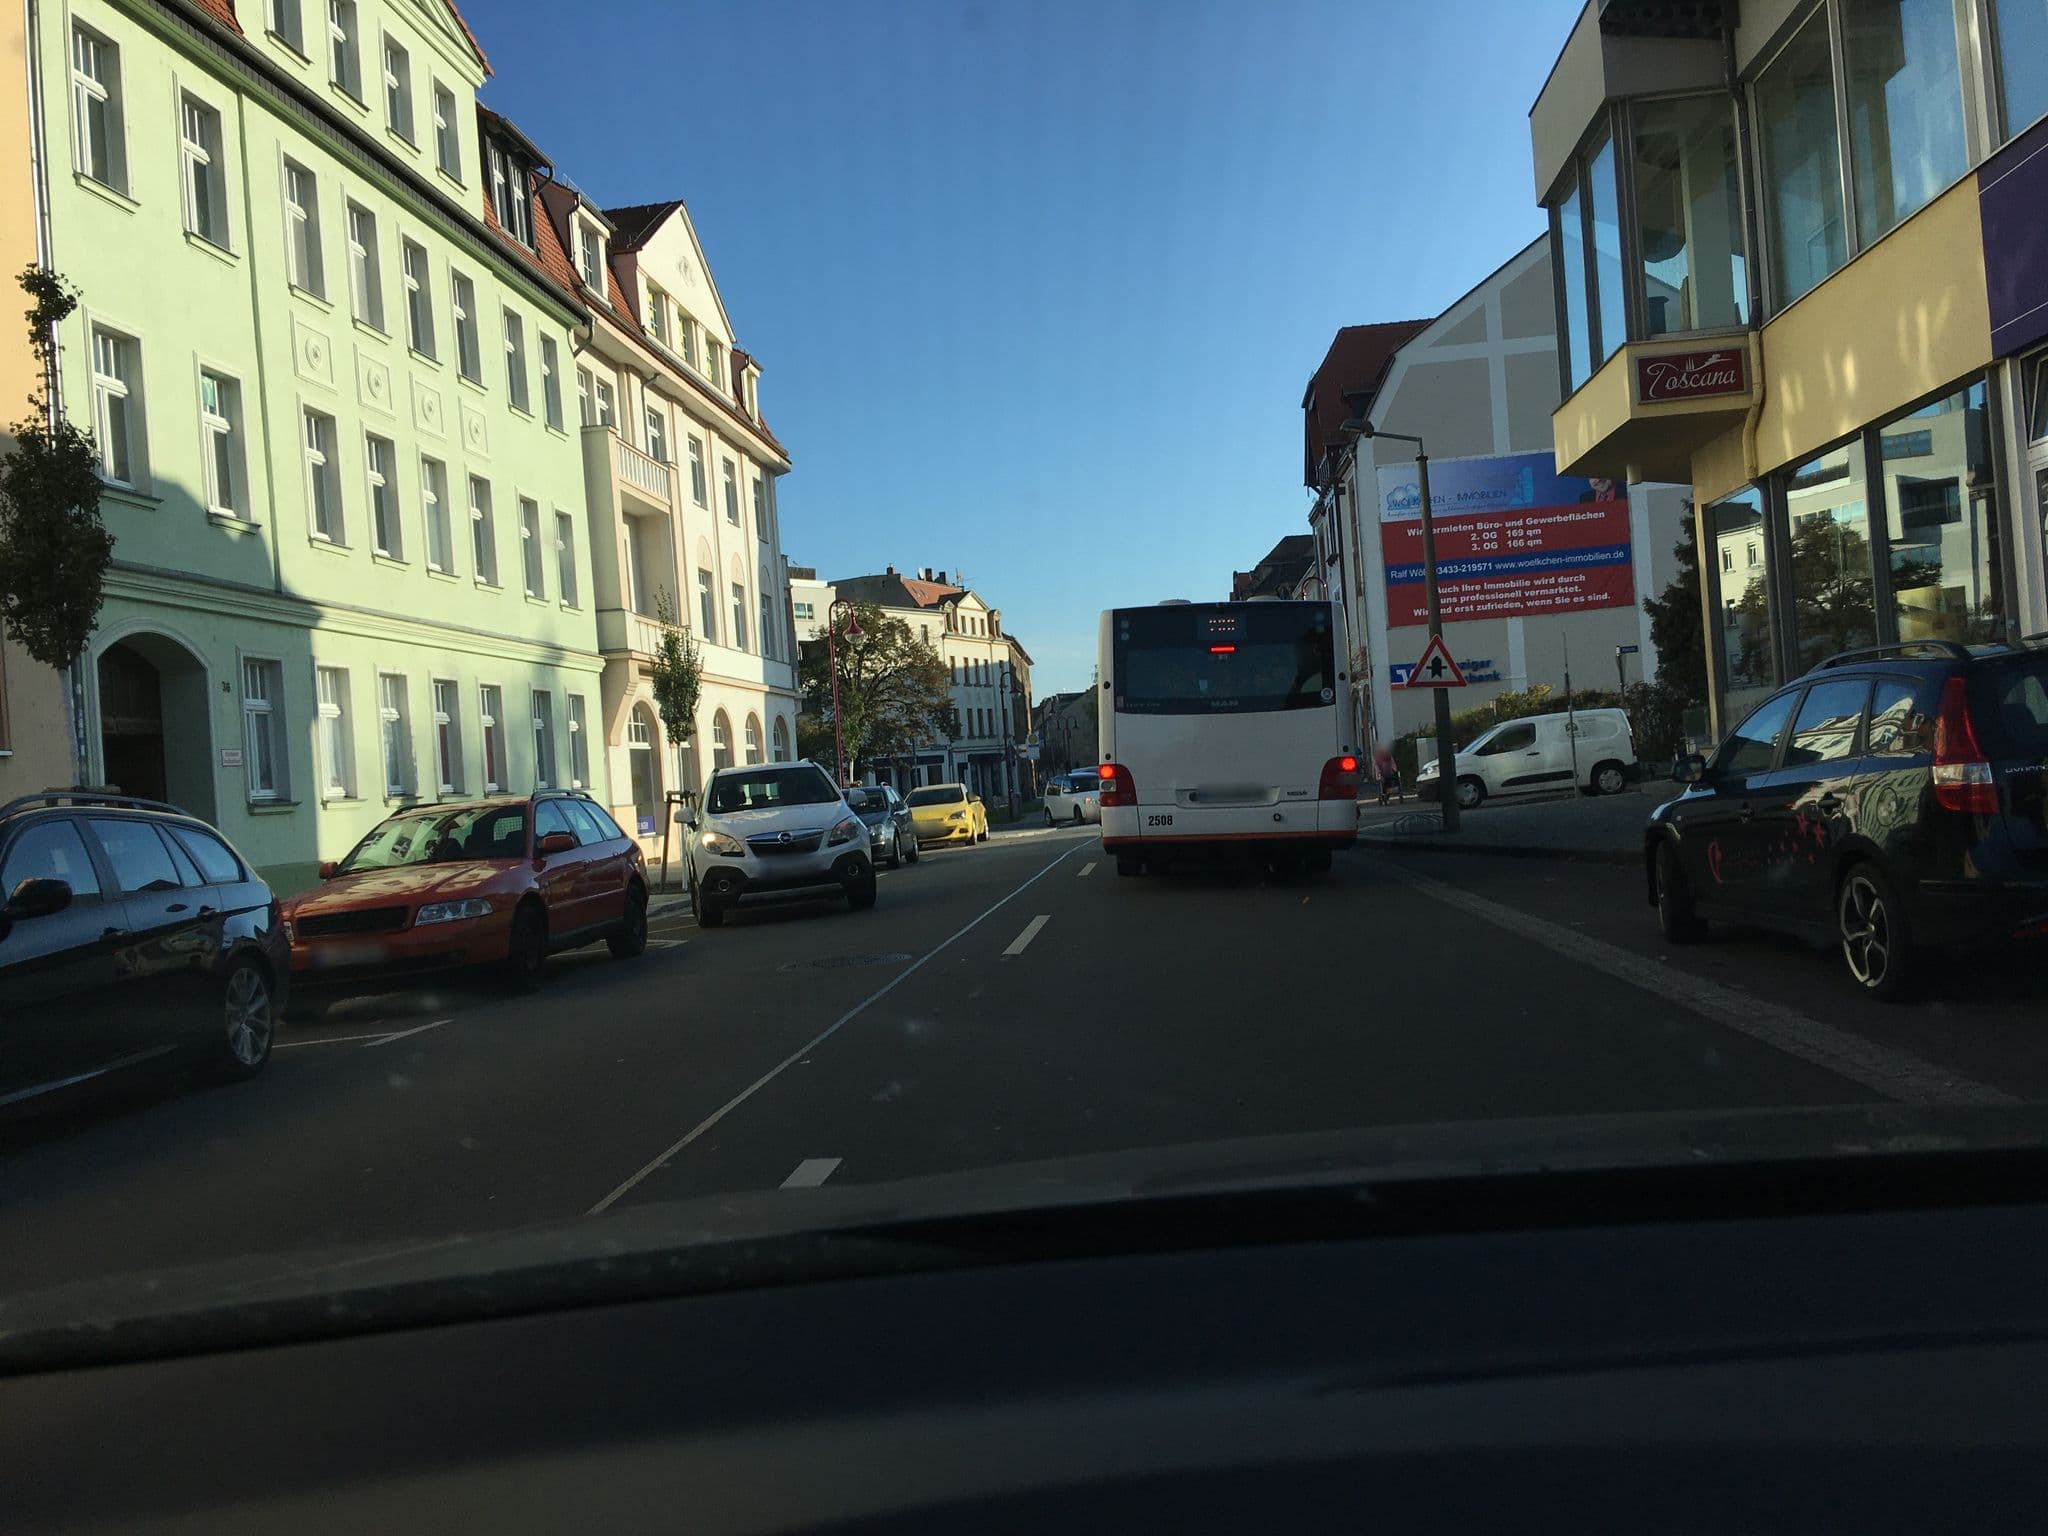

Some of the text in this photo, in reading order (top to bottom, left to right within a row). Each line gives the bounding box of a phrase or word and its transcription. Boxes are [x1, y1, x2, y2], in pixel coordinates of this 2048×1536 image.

[1646, 362, 1737, 398] Toscana
[1407, 511, 1605, 537] Wir ermieten Büro- und Gewerbeflächen
[1470, 528, 1542, 541] 2. OG 169 qm
[1471, 538, 1543, 551] 3. OG 166 qm
[1390, 569, 1408, 578] Ralf
[1409, 568, 1426, 577] Wöl
[1495, 550, 1625, 569] www.woelkchen-immobilien.de
[1461, 583, 1481, 592] Ihre
[1483, 579, 1531, 590] Immobilie
[1533, 576, 1555, 586] wird
[1557, 574, 1586, 583] durch
[1454, 604, 1474, 613] erst
[1476, 601, 1524, 611] zufrieden,
[1526, 598, 1553, 607] wenn
[1554, 596, 1571, 605] Sie
[1573, 595, 1585, 603] es
[1587, 592, 1611, 601] sind.
[1460, 590, 1522, 604] professionell
[1524, 585, 1582, 597] vermarktet.
[1148, 815, 1173, 826] 2508
